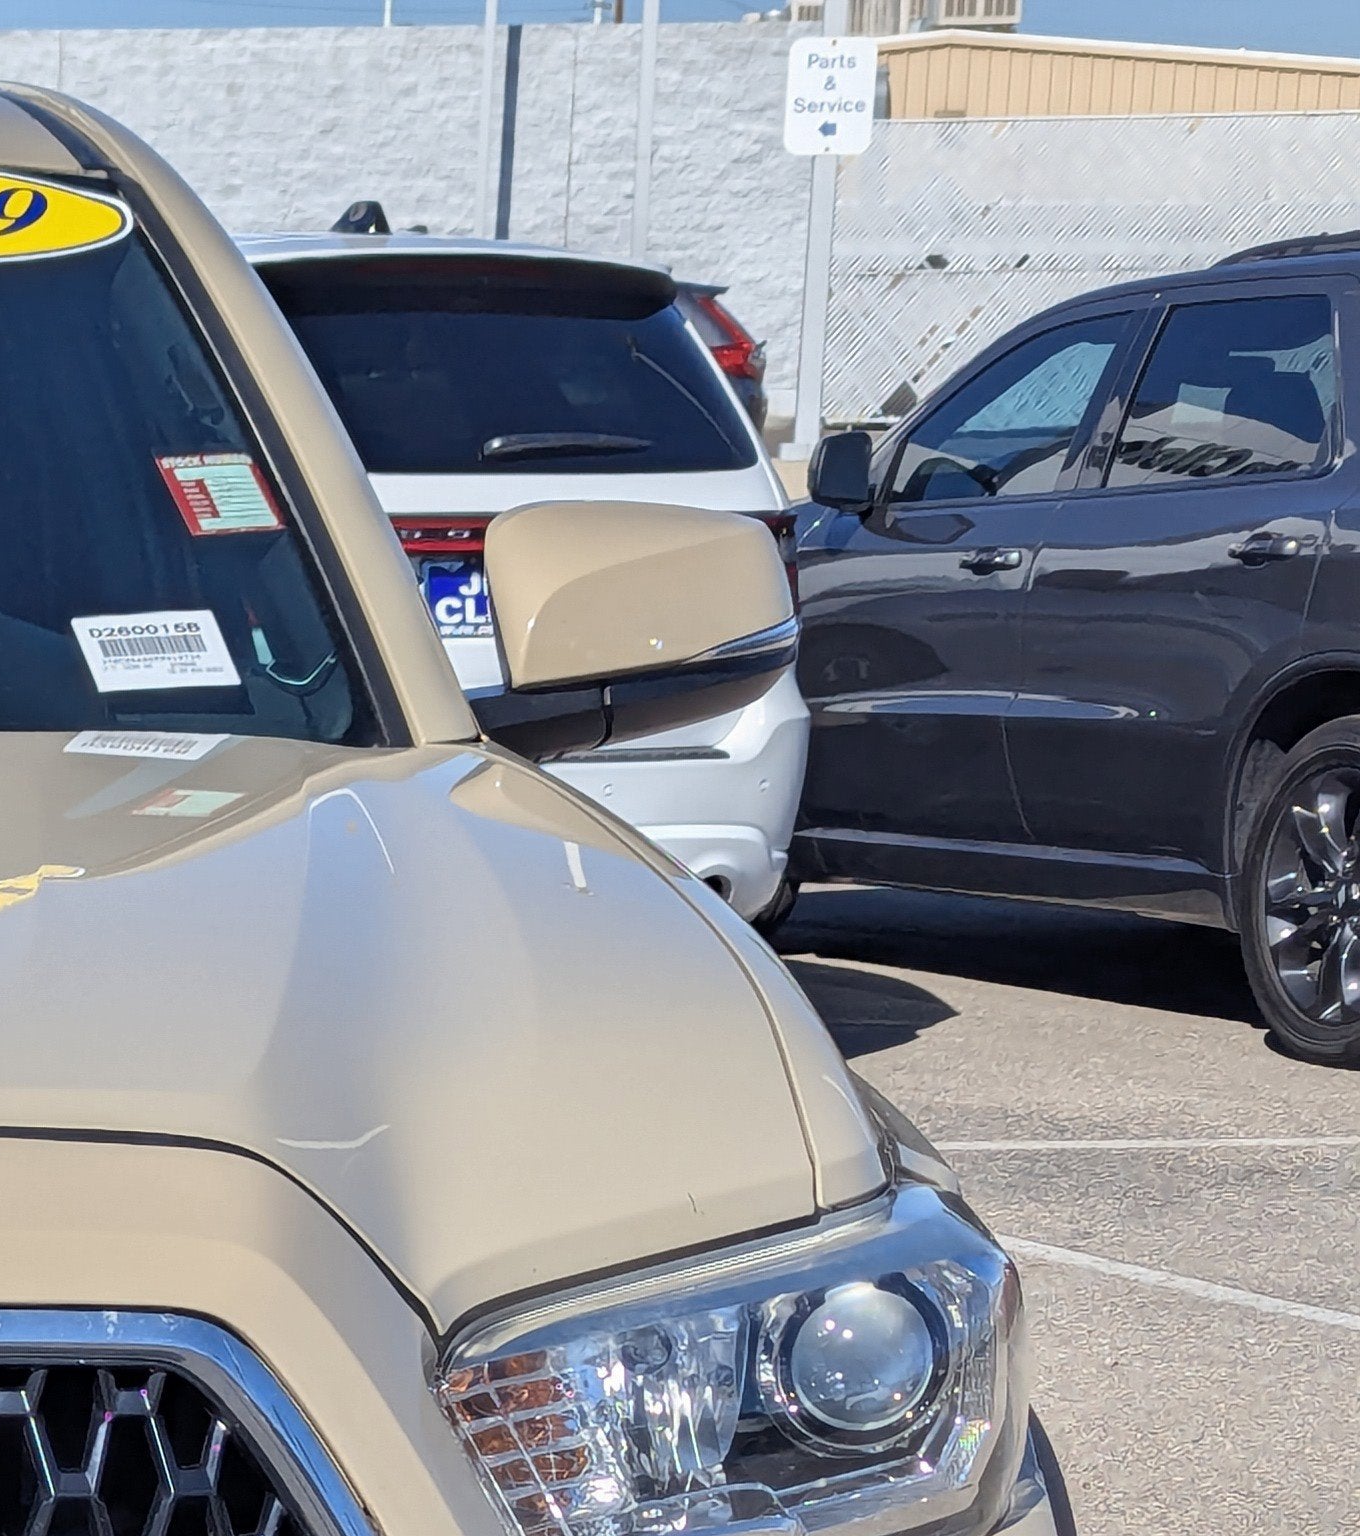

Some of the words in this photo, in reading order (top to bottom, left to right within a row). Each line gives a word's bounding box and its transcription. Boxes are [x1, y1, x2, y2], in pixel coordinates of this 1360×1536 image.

[807, 53, 856, 69] Parts
[824, 75, 836, 91] &
[793, 97, 866, 113] Service
